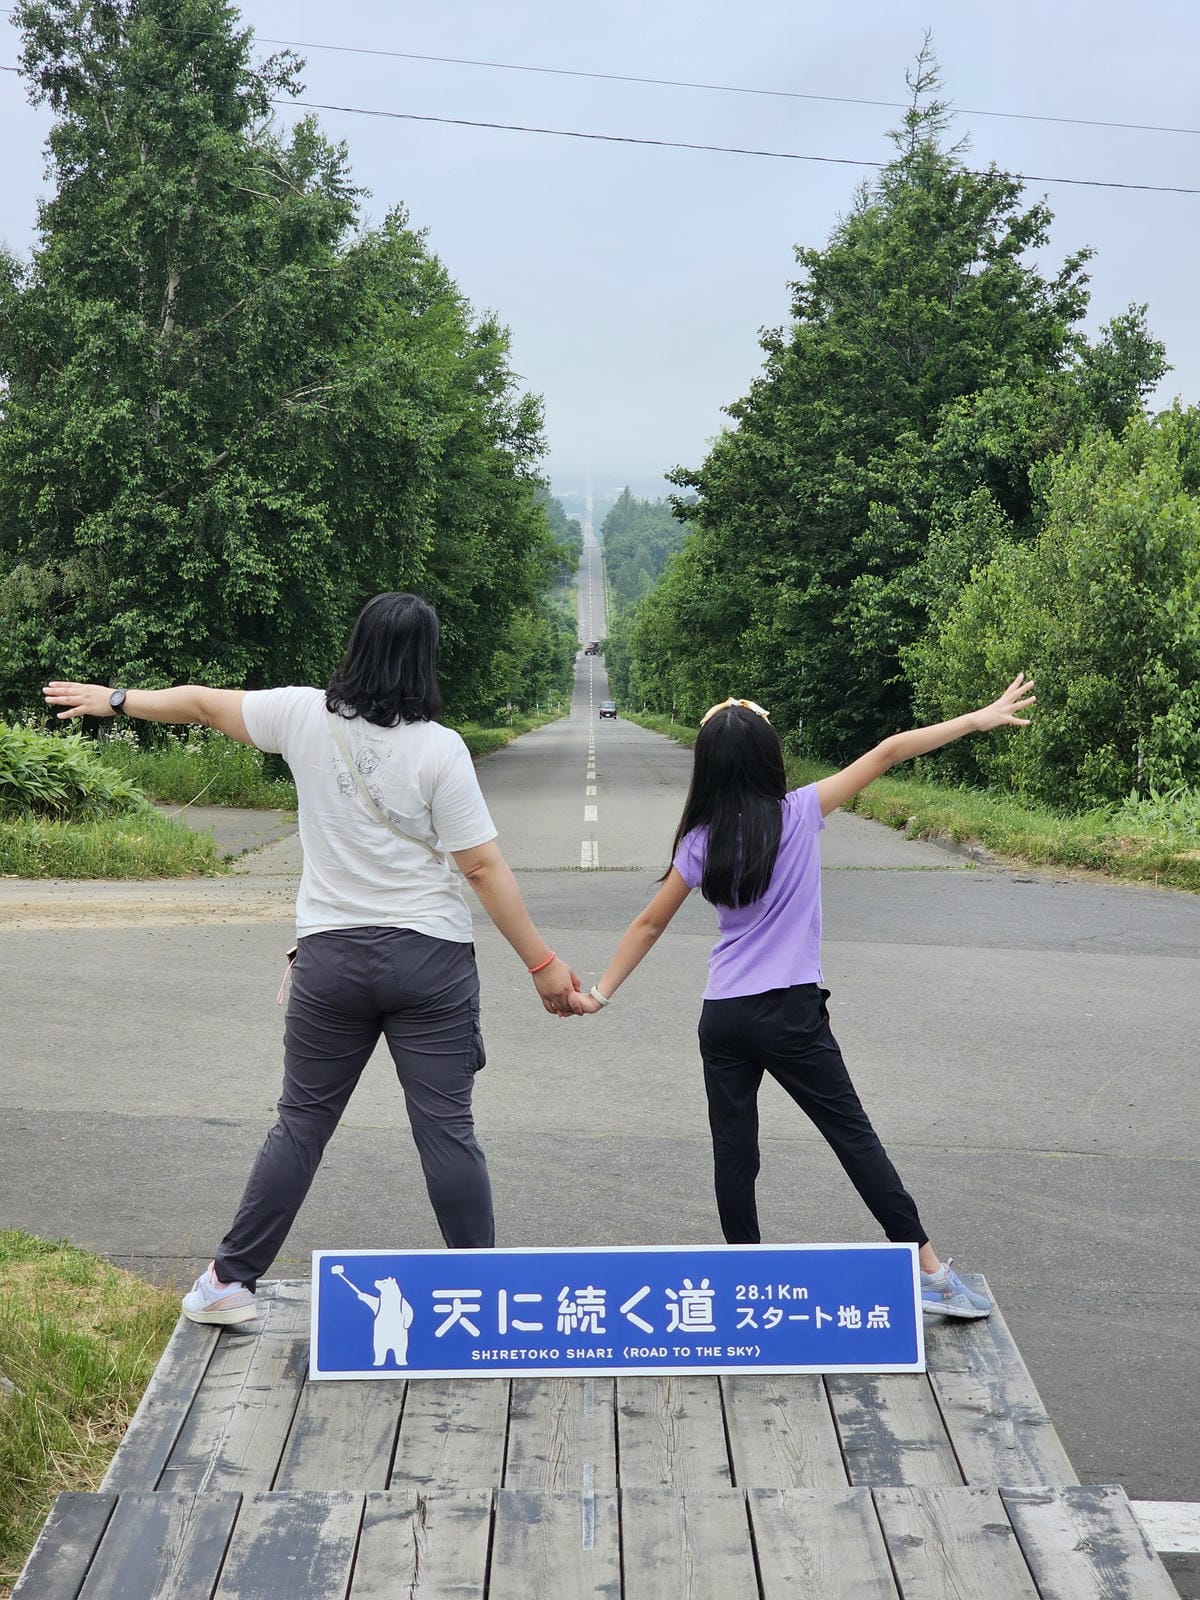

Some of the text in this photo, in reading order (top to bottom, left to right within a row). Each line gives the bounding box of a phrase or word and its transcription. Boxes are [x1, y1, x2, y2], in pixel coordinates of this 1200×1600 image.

[432, 1278, 717, 1337] 天に続く道
[735, 1304, 891, 1330] スタート地点
[471, 1348, 560, 1361] SHIRETOKO
[566, 1348, 613, 1359] SHARI
[672, 1347, 691, 1357] TO
[695, 1346, 722, 1357] THE
